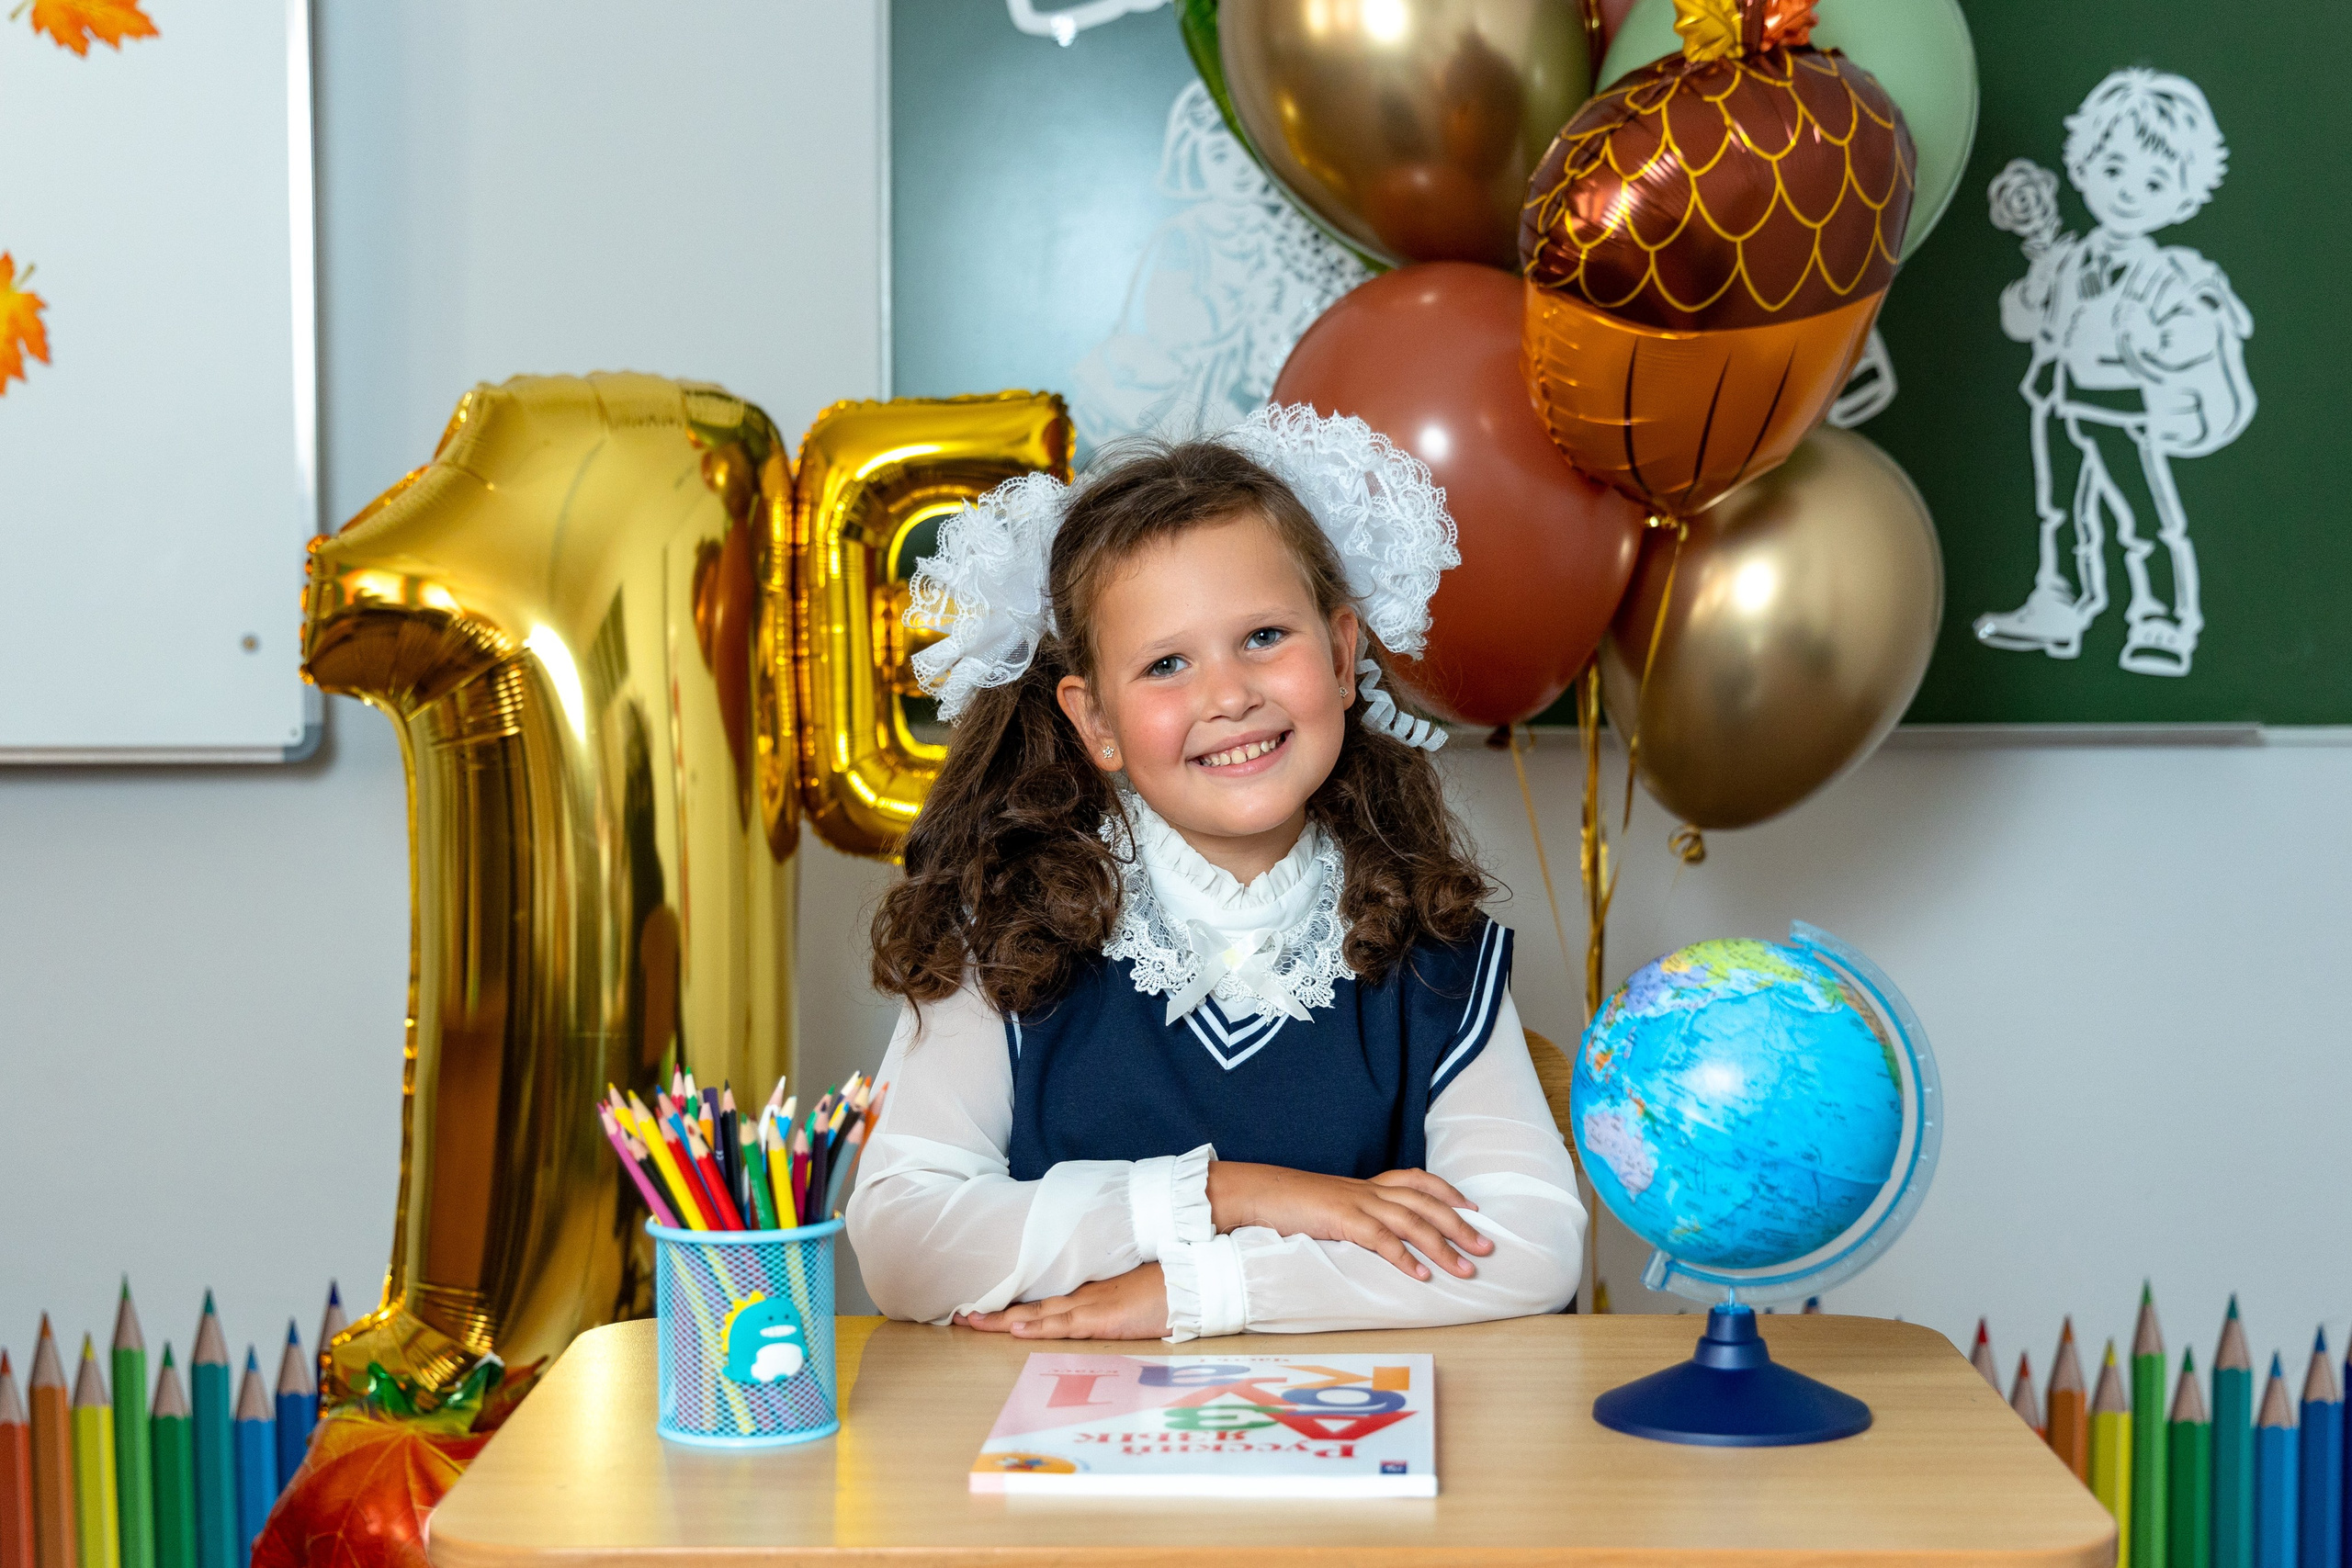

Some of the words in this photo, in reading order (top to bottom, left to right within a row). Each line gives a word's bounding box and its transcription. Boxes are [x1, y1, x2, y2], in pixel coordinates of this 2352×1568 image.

[1040, 1373, 1120, 1408] 1
[1073, 1430, 1250, 1444] язык
[1121, 1439, 1357, 1459] Русский
